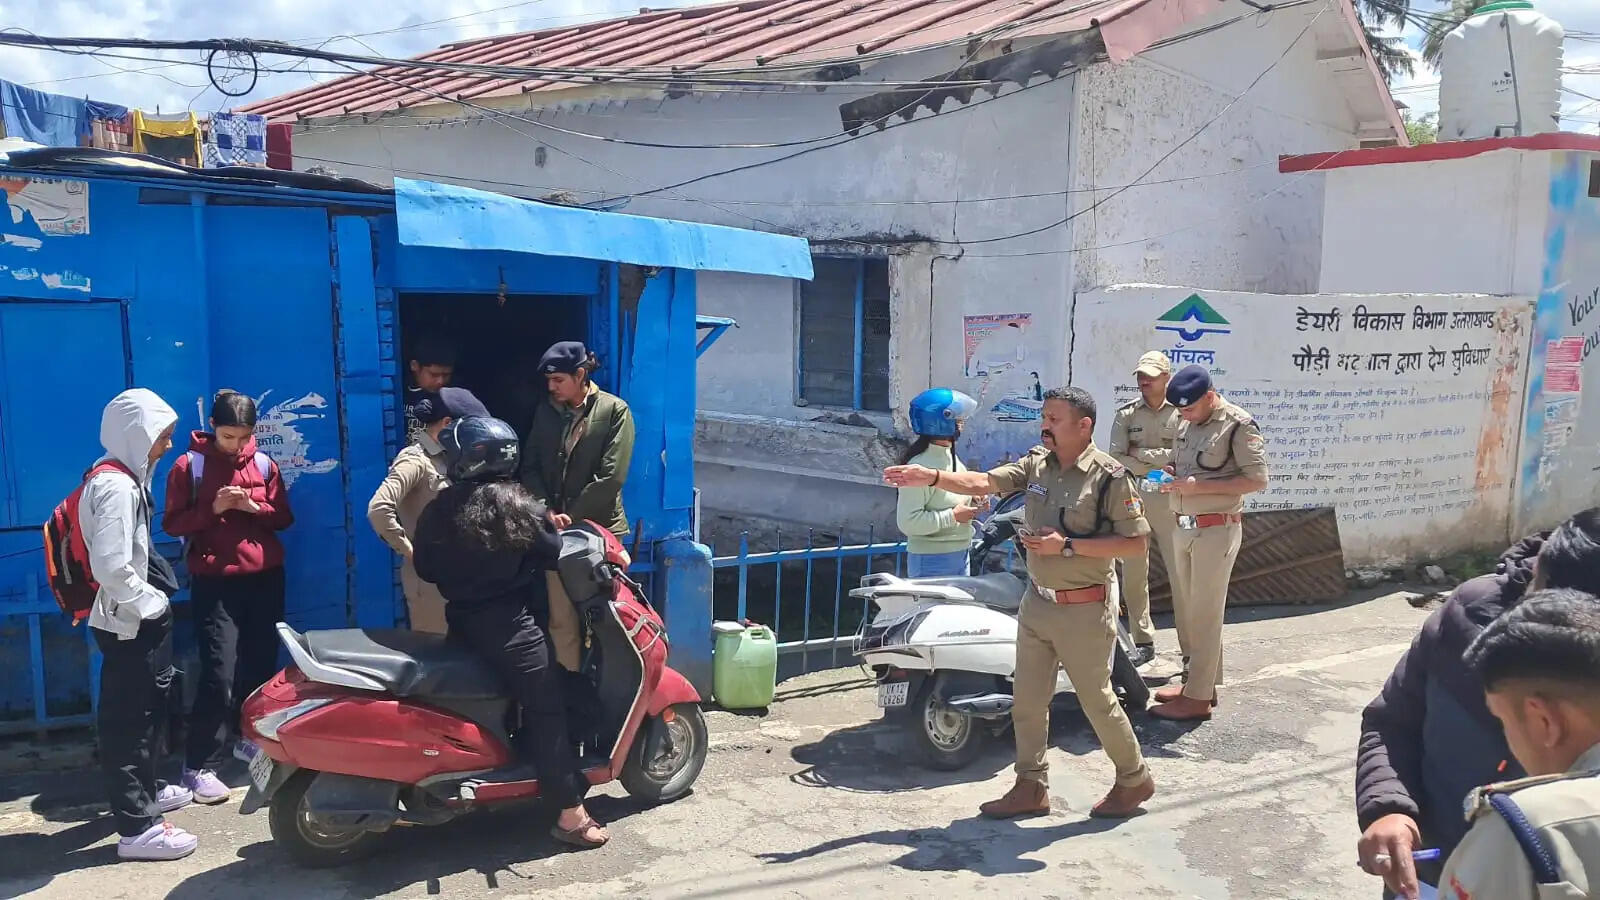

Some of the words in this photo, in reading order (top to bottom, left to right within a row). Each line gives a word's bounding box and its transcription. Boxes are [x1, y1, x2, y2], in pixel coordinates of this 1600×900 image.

[1352, 304, 1406, 331] विकास
[1413, 305, 1448, 330] विभाग
[1292, 344, 1331, 376] पौड़ी
[1394, 352, 1423, 375] द्वारा
[1428, 345, 1447, 371] देय
